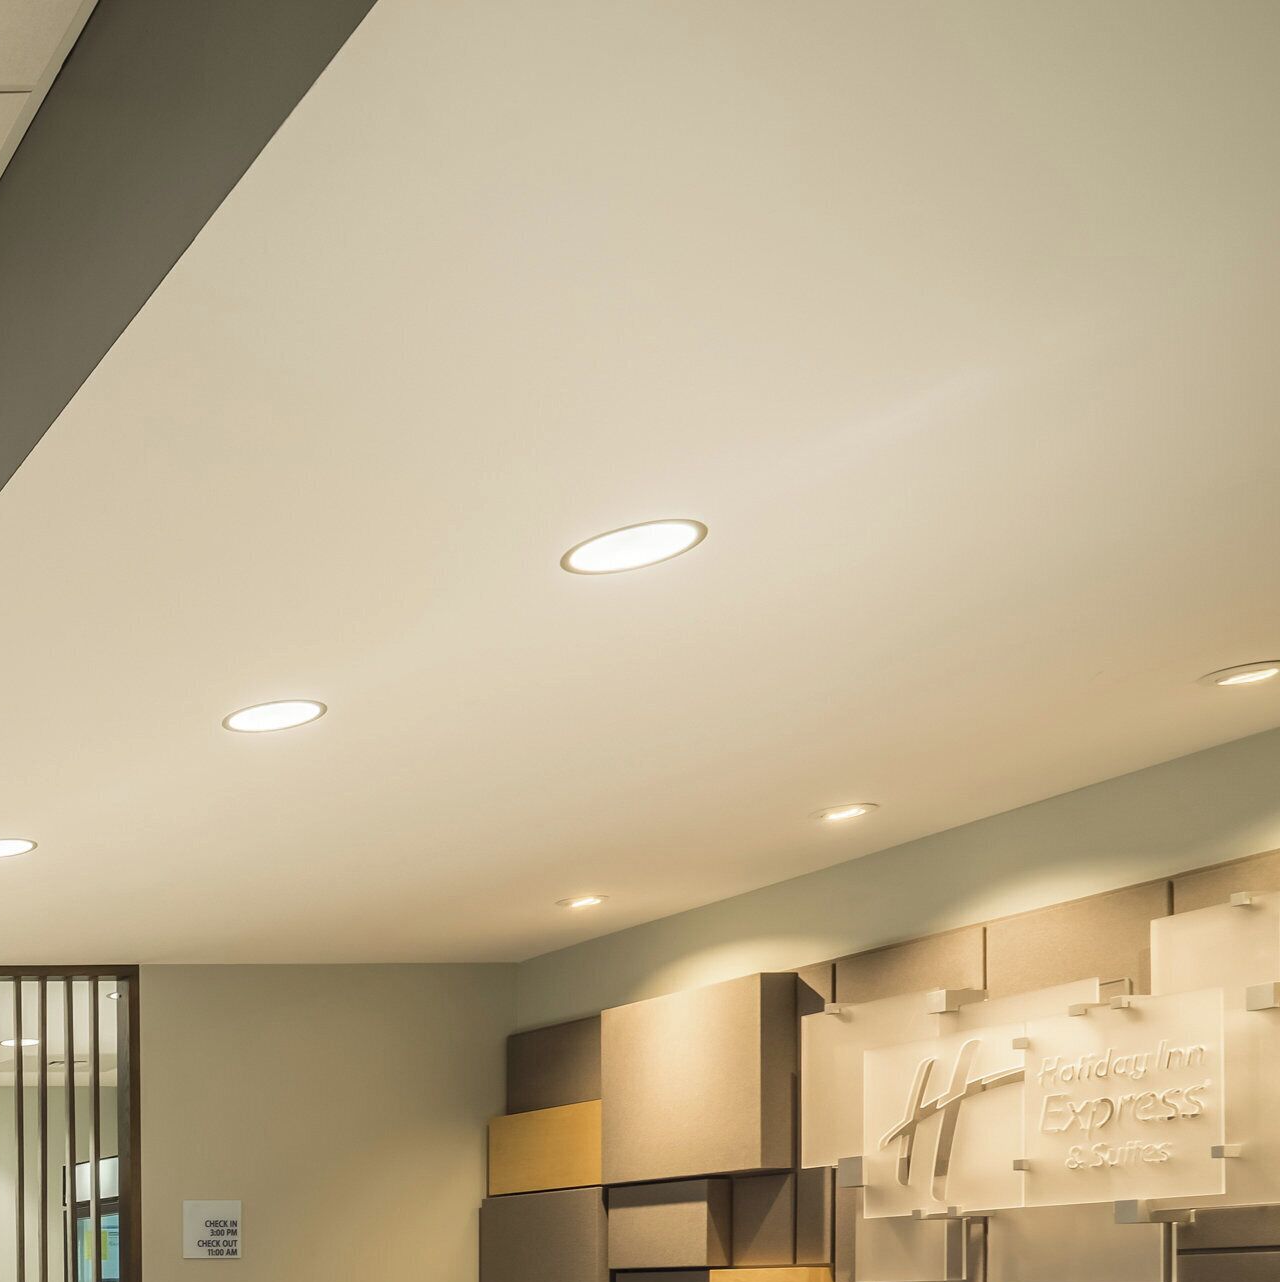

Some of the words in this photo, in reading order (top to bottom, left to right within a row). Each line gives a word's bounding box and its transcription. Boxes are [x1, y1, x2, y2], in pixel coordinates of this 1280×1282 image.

[1038, 1048, 1152, 1087] Holiday
[1156, 1040, 1206, 1070] Inn
[1040, 1083, 1206, 1140] Express
[1065, 1145, 1086, 1169] &
[1089, 1140, 1173, 1168] Suites
[197, 1239, 221, 1247] CHECK
[222, 1239, 238, 1247] OUT
[207, 1248, 224, 1256] 11:00
[225, 1248, 238, 1256] AM
